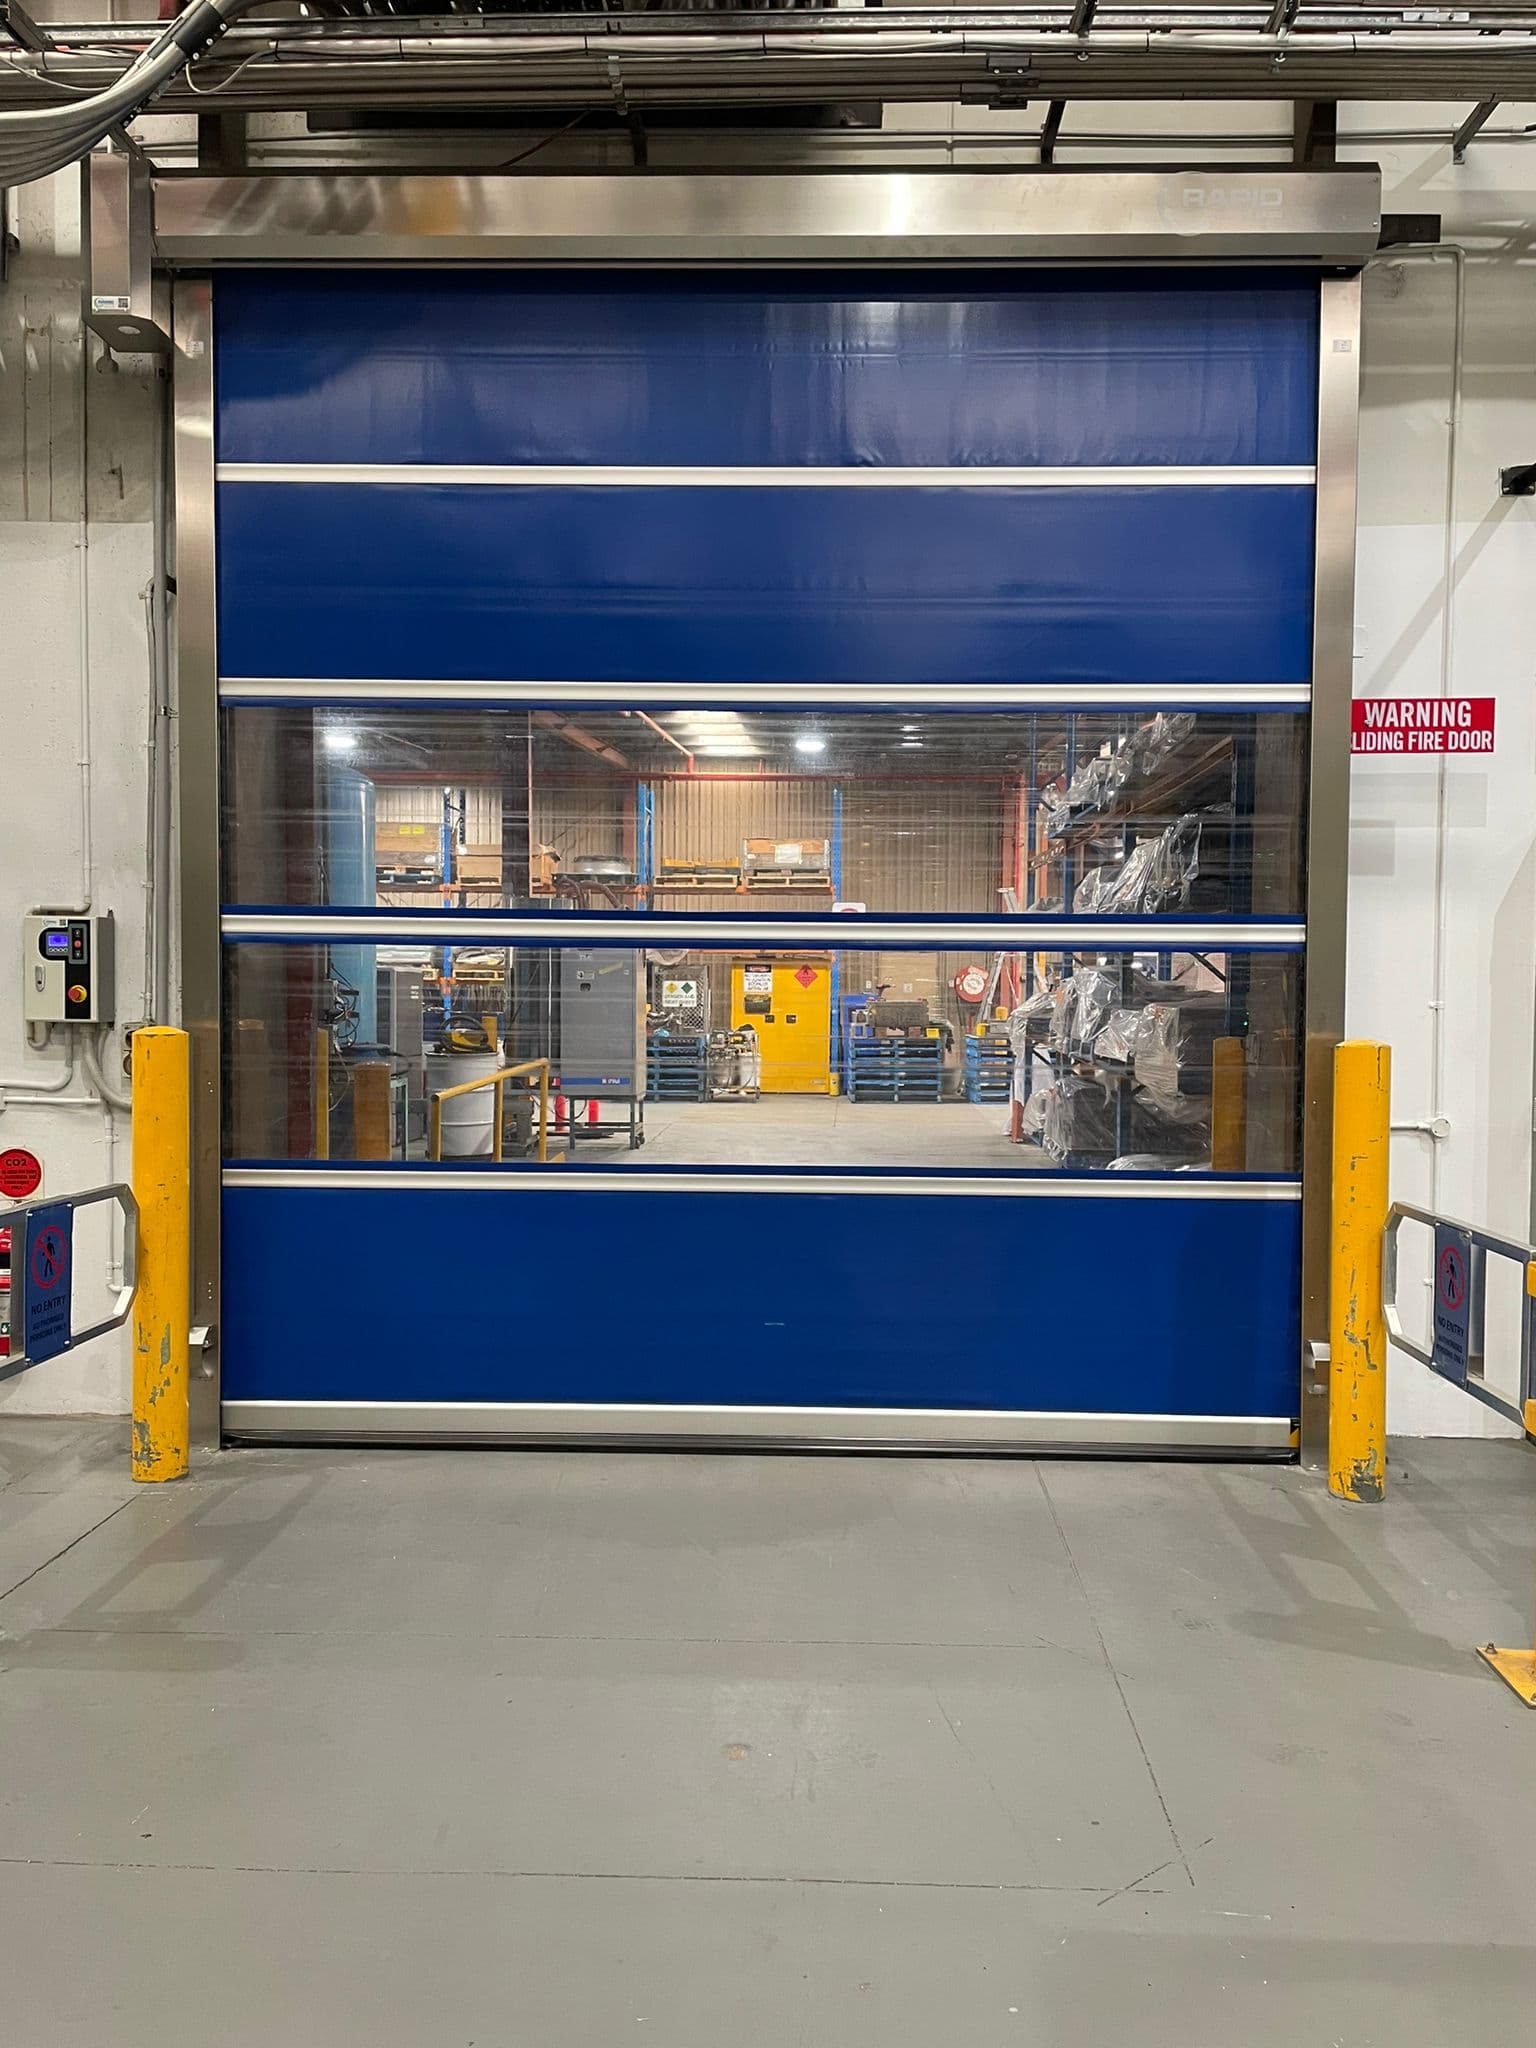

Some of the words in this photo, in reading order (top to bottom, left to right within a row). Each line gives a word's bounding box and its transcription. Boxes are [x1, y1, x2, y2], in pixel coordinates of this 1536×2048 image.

[1183, 188, 1283, 208] RAPID
[1364, 701, 1472, 728] WARNING
[1352, 731, 1404, 751] LIDING
[1408, 731, 1444, 750] FIRE
[1448, 730, 1493, 750] DOOR
[5, 1158, 27, 1167] CO2
[31, 1303, 42, 1315] NO
[43, 1295, 66, 1311] ENTRY
[1438, 1315, 1446, 1328] NO
[1446, 1319, 1465, 1337] ENTRY
